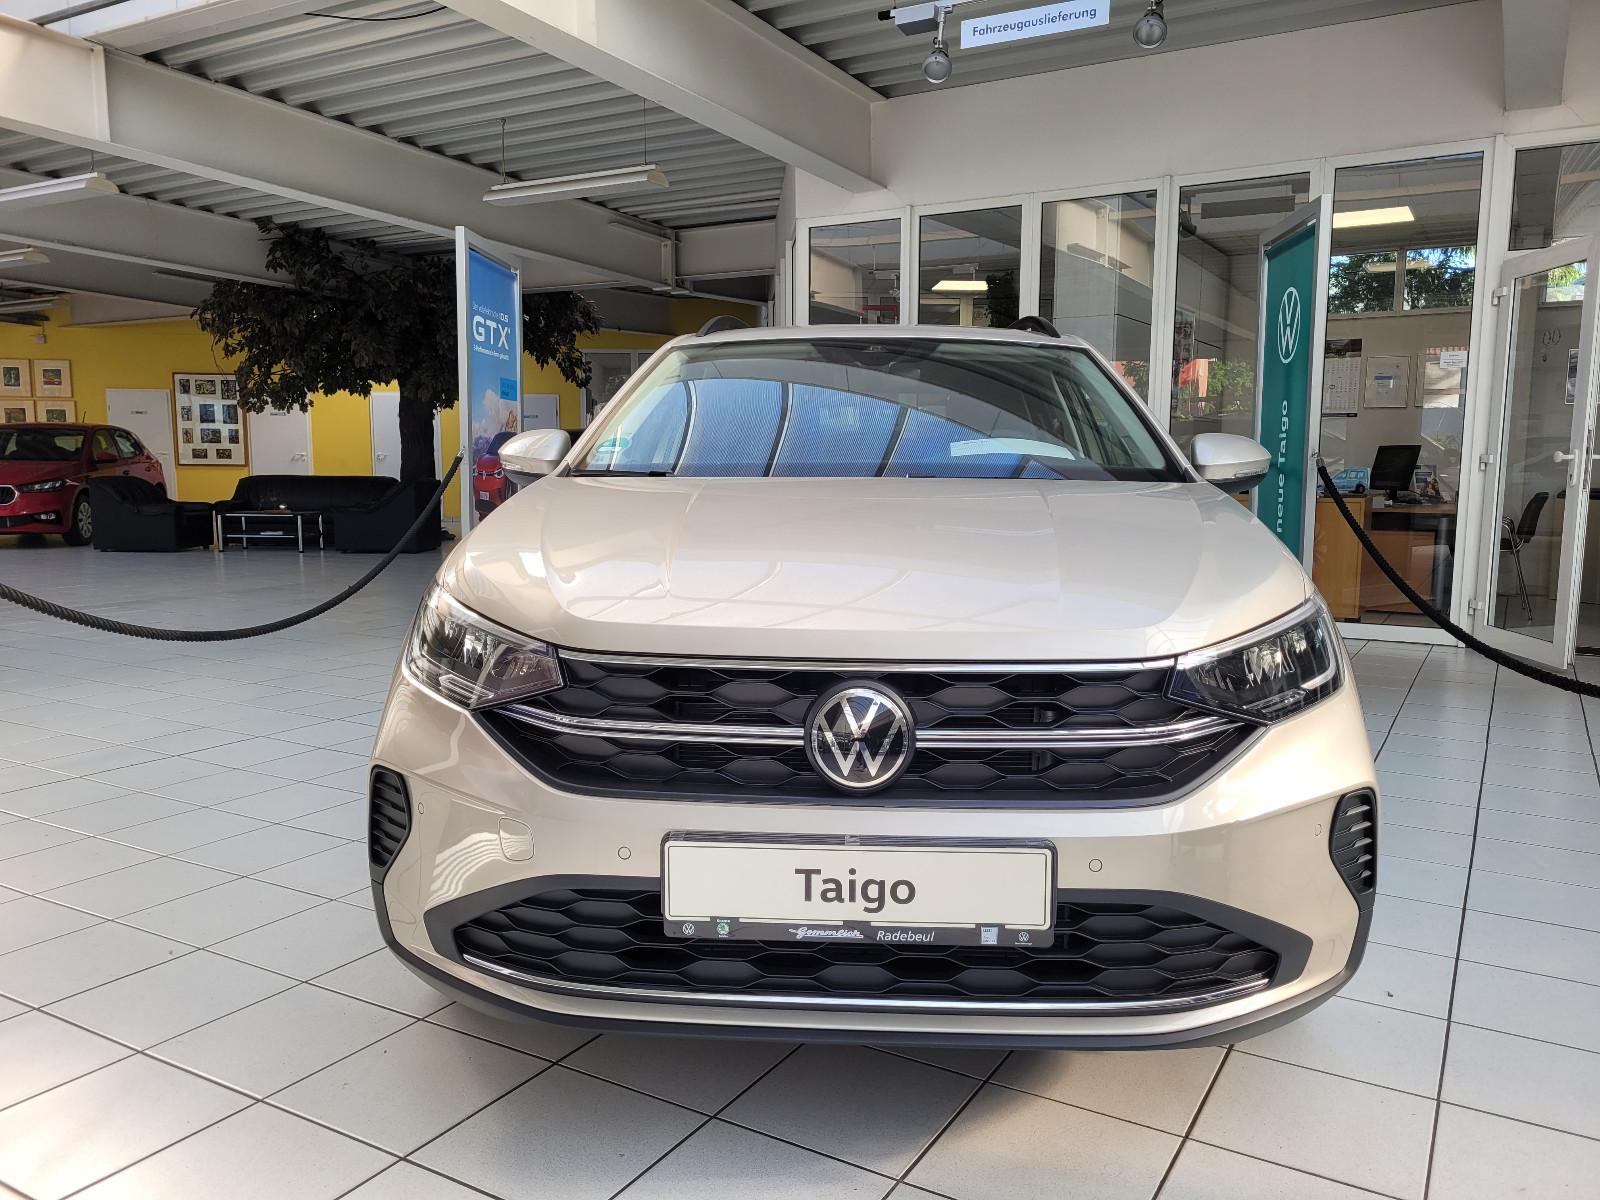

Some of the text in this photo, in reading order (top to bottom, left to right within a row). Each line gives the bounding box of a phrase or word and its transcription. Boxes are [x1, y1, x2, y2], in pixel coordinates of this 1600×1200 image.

[972, 8, 1097, 37] Fahrzeugauslieferung
[1276, 400, 1289, 533] neue Taigo
[794, 868, 916, 914] Taigo
[876, 930, 935, 942] Radebeul
